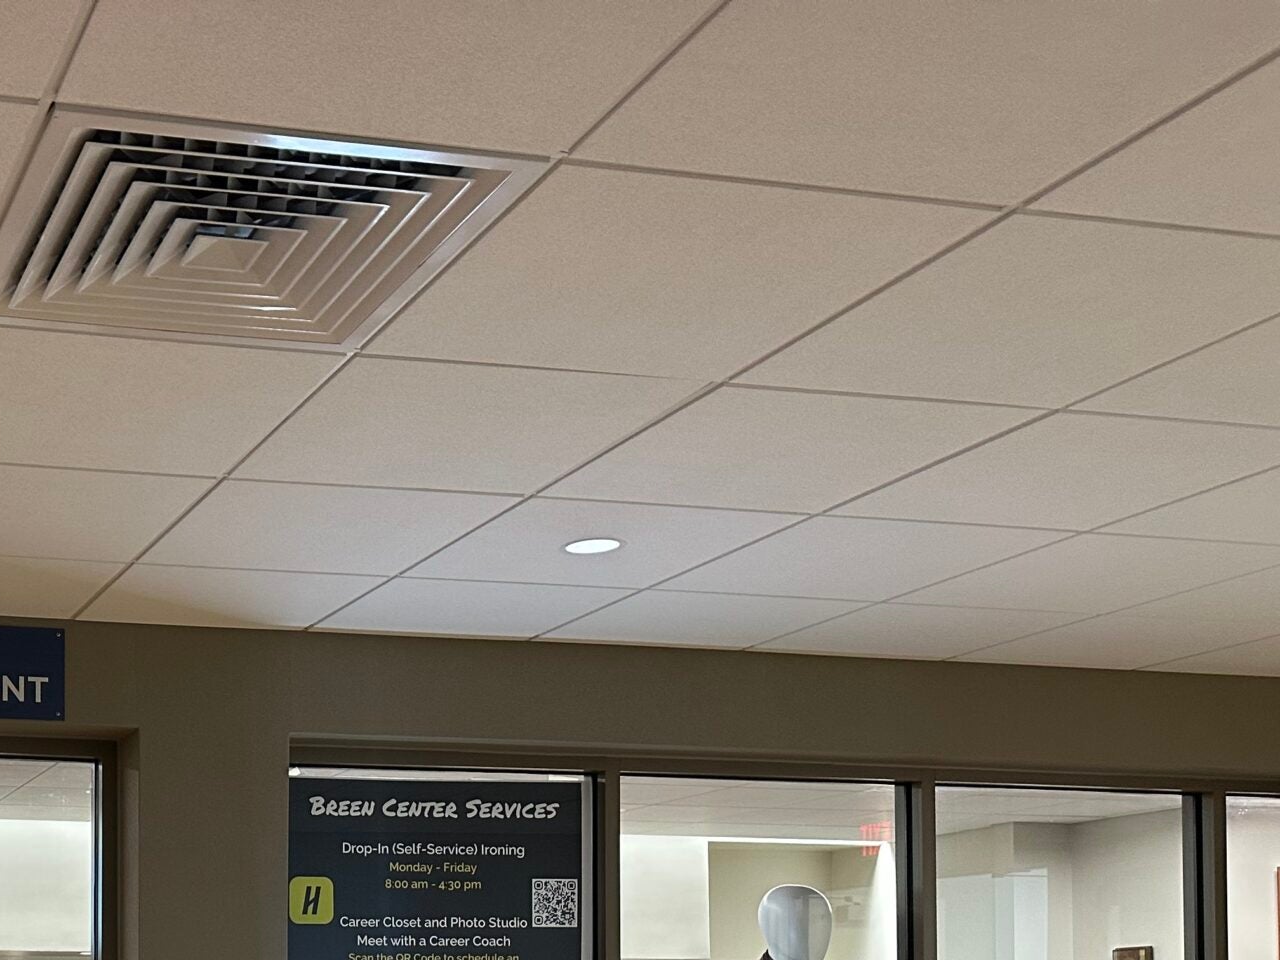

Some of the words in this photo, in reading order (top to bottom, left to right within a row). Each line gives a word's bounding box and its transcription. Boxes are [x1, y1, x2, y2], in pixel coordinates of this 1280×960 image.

[308, 795, 375, 816] BREEN
[382, 798, 458, 818] CENTER
[465, 799, 560, 819] SERVICES
[342, 842, 389, 856] Drop-In
[392, 843, 478, 856] (Self-Service)
[481, 844, 525, 858] Ironing
[389, 862, 433, 874] Monday
[443, 862, 478, 875] Friday
[384, 879, 409, 890] 8:00
[411, 881, 428, 890] am
[438, 880, 461, 891] 4:30
[464, 881, 482, 892] pm
[339, 916, 380, 928] Career
[382, 916, 422, 928] Closet
[424, 917, 448, 928] and
[450, 917, 486, 928] Photo
[488, 917, 528, 929] Studio
[357, 935, 388, 947] Meet
[390, 935, 416, 947] with
[418, 938, 427, 947] a
[429, 935, 470, 947] Career
[472, 935, 511, 947] Coach
